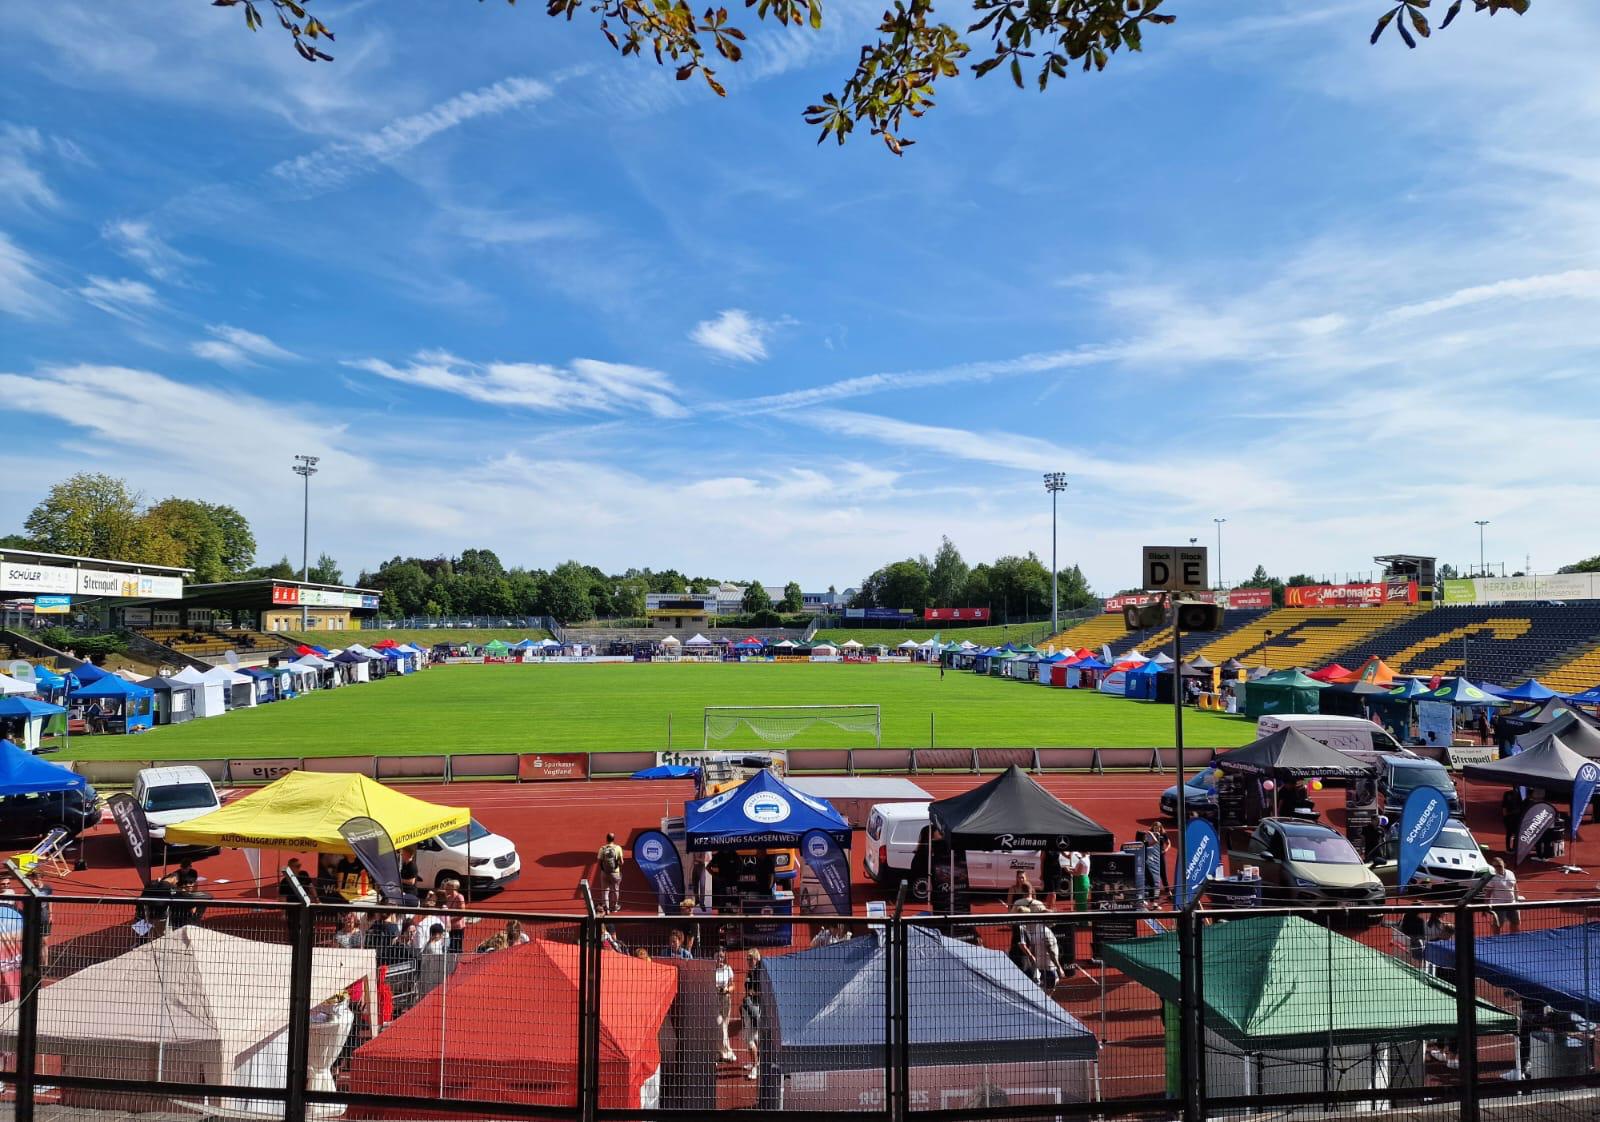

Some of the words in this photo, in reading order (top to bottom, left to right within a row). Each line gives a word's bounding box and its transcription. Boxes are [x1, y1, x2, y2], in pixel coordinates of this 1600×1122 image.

[8, 569, 42, 581] SCHÜLER
[1150, 562, 1170, 586] D
[1183, 562, 1200, 585] E
[83, 575, 118, 593] Sternquell
[1323, 587, 1382, 599] McDonald's
[544, 761, 575, 769] Sparkasse
[1451, 754, 1491, 765] Sternquell
[543, 768, 573, 776] Vogtland
[1405, 799, 1438, 844] SCHNEIDER
[394, 823, 440, 845] AUTOHAUSGRUPPE
[439, 817, 457, 832] DORNIG
[221, 835, 288, 846] AUTOHAUSGRUPPE
[288, 840, 318, 848] DORNIG
[694, 835, 742, 845] KFZ-INNUNG
[743, 834, 779, 843] SACHSEN
[779, 834, 799, 842] WEST
[994, 833, 1047, 848] Reißmann
[1185, 834, 1210, 881] CHNEIDER
